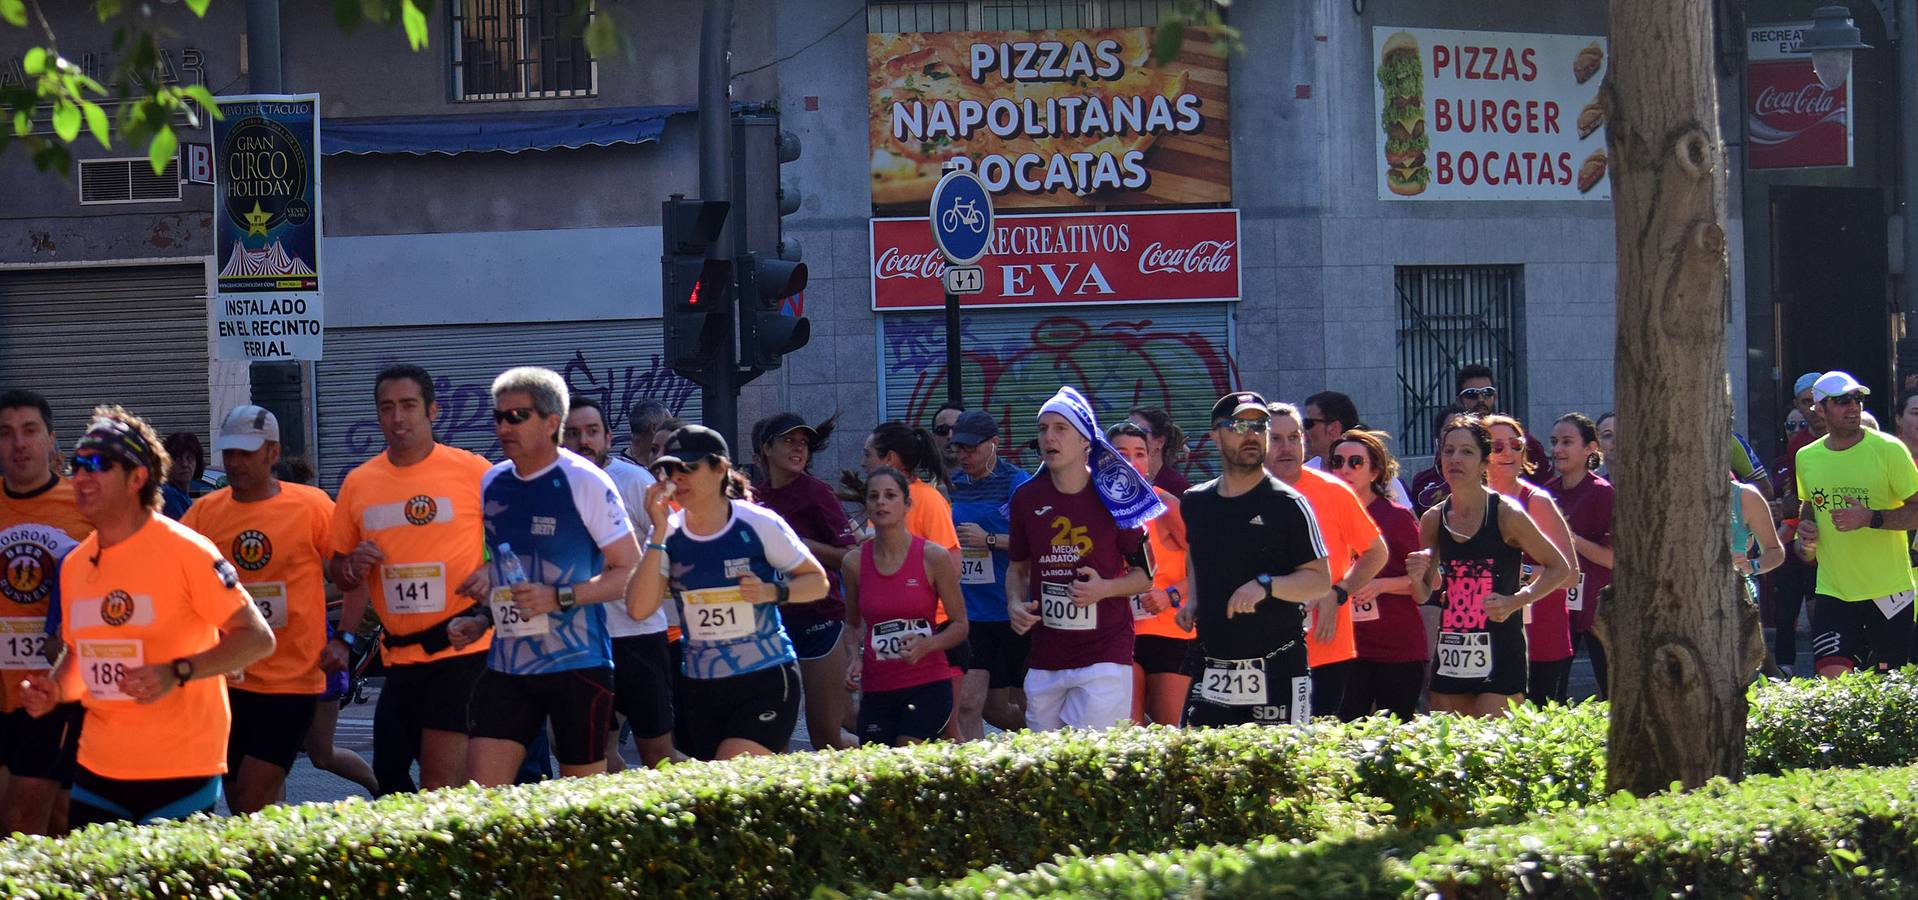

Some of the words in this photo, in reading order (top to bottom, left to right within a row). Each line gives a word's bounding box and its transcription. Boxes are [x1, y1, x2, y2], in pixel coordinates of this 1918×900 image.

[1752, 29, 1805, 42] RECREAT
[970, 40, 1122, 81] PIZZAS
[1433, 45, 1537, 81] PIZZAS
[1755, 84, 1835, 115] Coca-Cola
[893, 94, 1202, 139] NAPOLITANAS
[1435, 99, 1559, 134] BURGER
[237, 135, 274, 150] GRAN
[230, 151, 287, 180] CIRCO
[1436, 151, 1572, 186] BOCATAS
[228, 180, 294, 197] HOLIDAY
[984, 223, 1130, 256] RECREATIVOS
[875, 247, 945, 280] Coca-Co
[1138, 240, 1236, 274] Coca-Cola
[998, 262, 1115, 297] EVA
[225, 299, 306, 316] INSTALADO
[219, 321, 236, 337] EN
[237, 320, 250, 336] EL
[252, 319, 320, 337] RECINTO
[244, 340, 292, 357] FERIAL
[0, 530, 57, 550] OGROÑO
[1051, 516, 1093, 557] 25
[5, 545, 43, 558] BEER
[1052, 545, 1079, 554] MEDIA
[395, 582, 429, 601] 141
[500, 606, 529, 624] 25
[698, 607, 736, 627] 251
[1045, 599, 1089, 620] 2001
[1443, 609, 1488, 629] BODY
[8, 637, 46, 656] 132
[1463, 634, 1481, 645] 7K
[1441, 649, 1486, 668] 2073
[91, 662, 125, 684] 188
[1207, 674, 1260, 694] 2213
[1252, 705, 1286, 719] SDi
